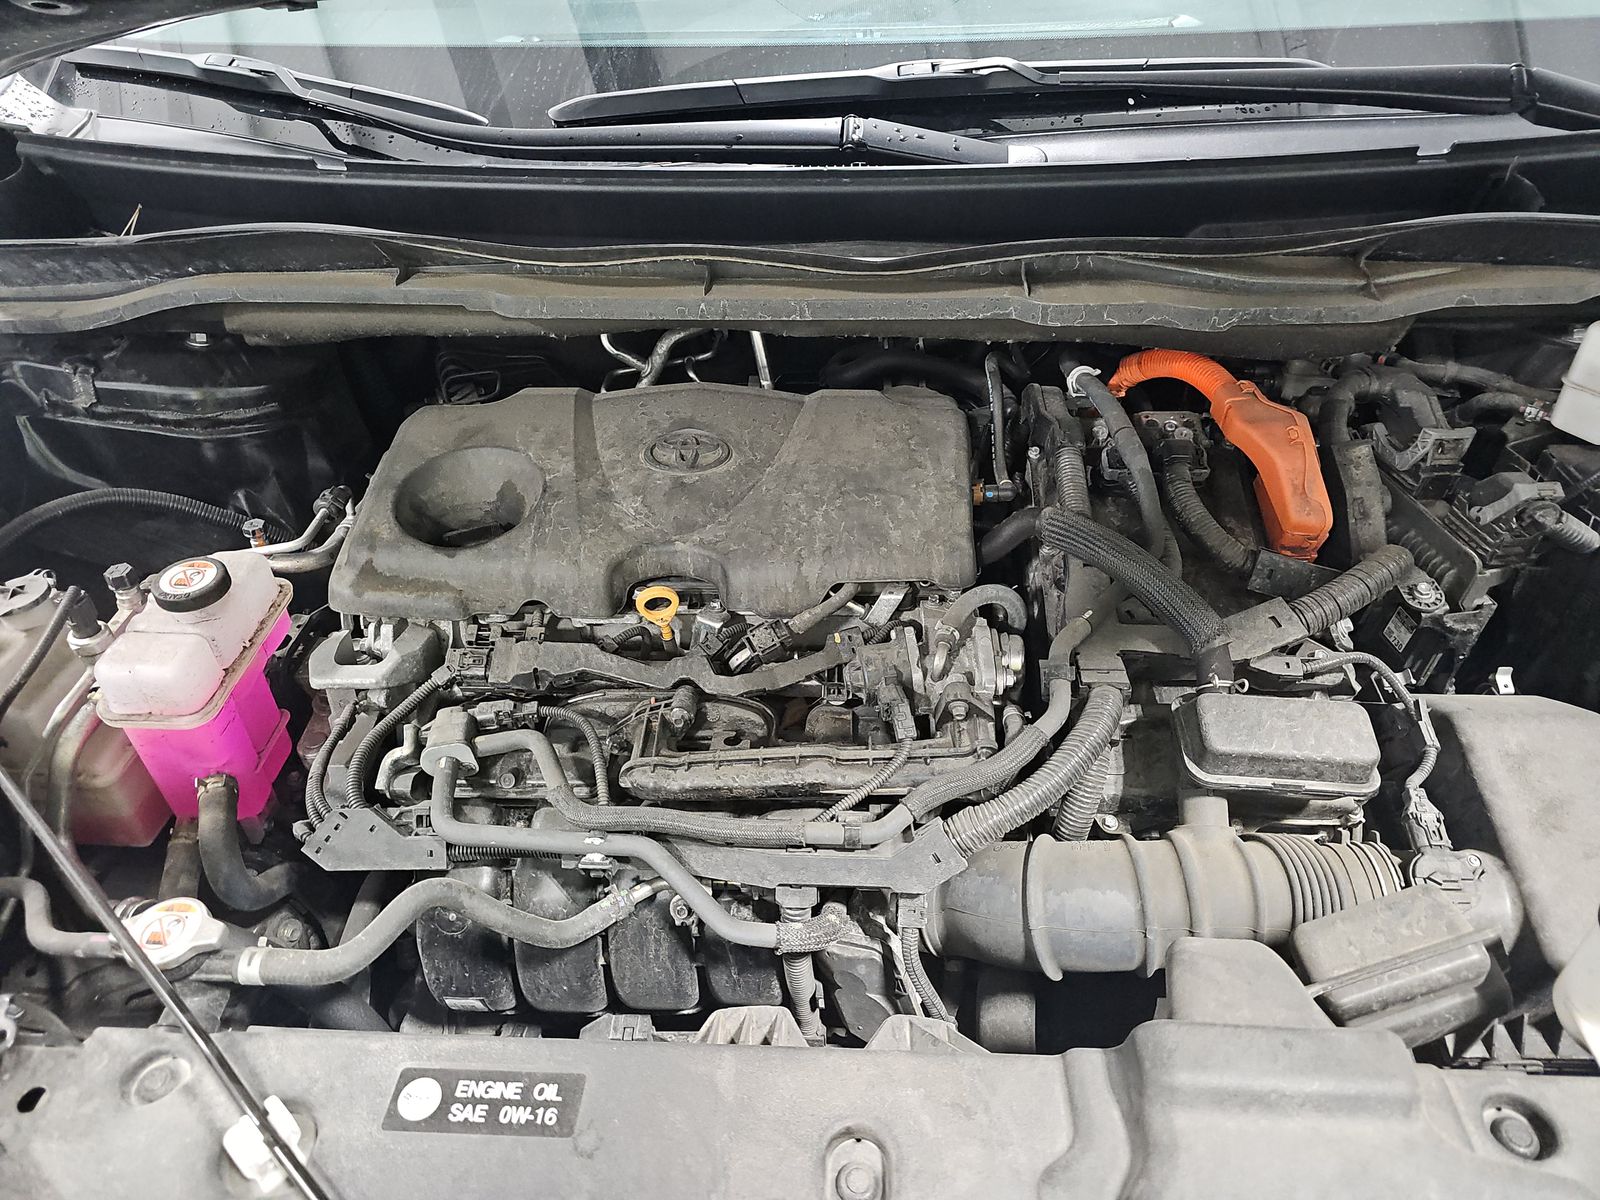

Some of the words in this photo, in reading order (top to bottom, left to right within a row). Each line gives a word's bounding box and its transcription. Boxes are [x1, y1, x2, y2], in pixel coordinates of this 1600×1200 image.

[1391, 635, 1403, 651] 730
[454, 1080, 524, 1100] ENGINE
[533, 1083, 562, 1101] OIL
[448, 1103, 489, 1122] SAE
[499, 1105, 558, 1126] 0W-16
